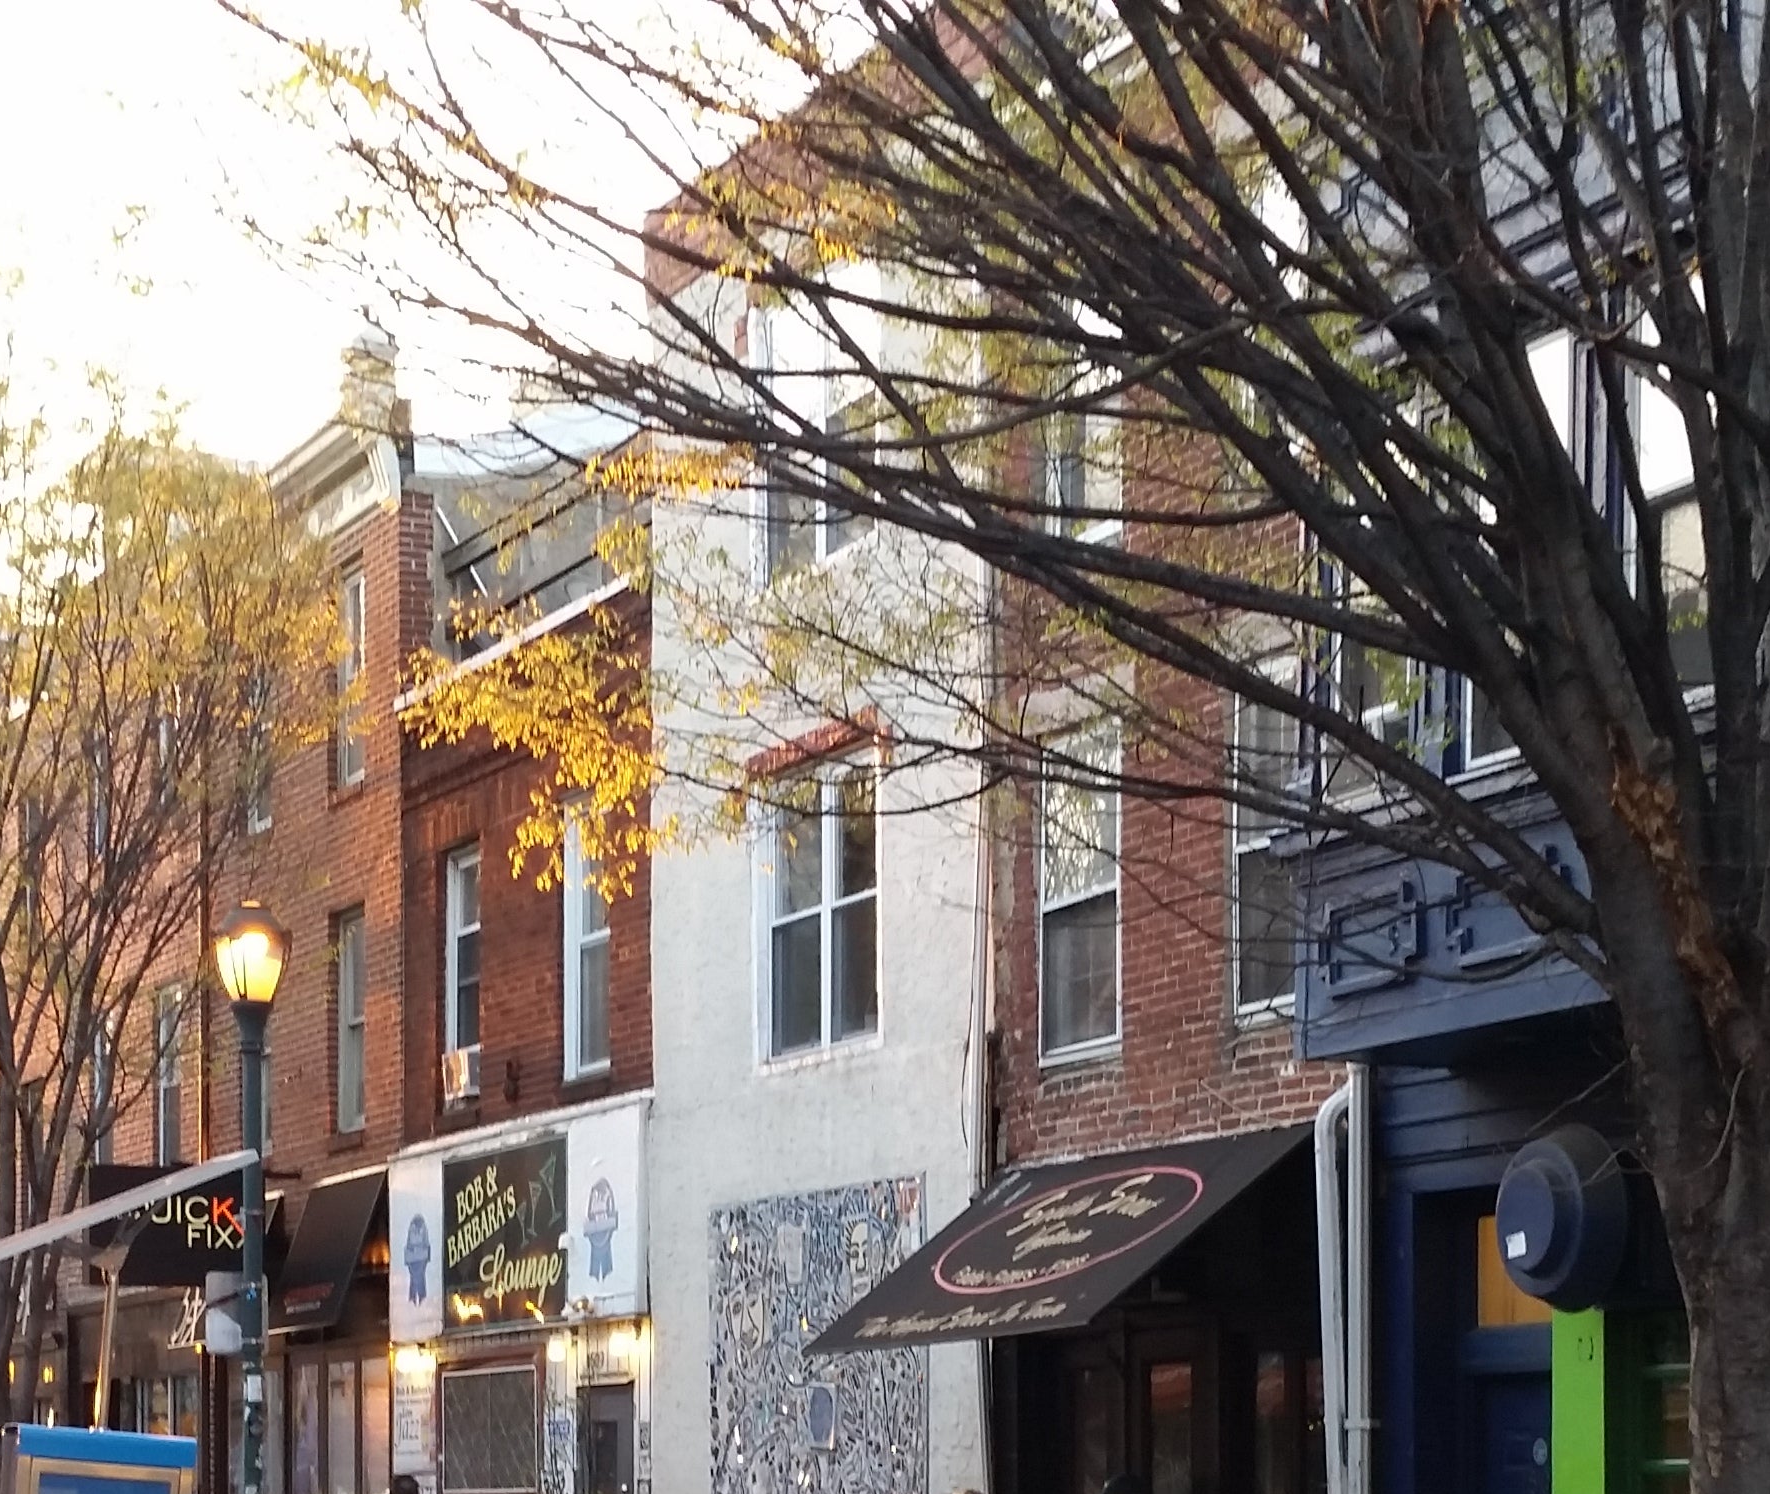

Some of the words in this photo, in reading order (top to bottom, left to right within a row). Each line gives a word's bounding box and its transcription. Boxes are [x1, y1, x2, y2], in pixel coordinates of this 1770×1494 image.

[446, 1184, 517, 1269] BARBARA'S
[456, 1174, 483, 1225] BOB
[486, 1164, 499, 1200] &
[479, 1242, 563, 1308] Lounge
